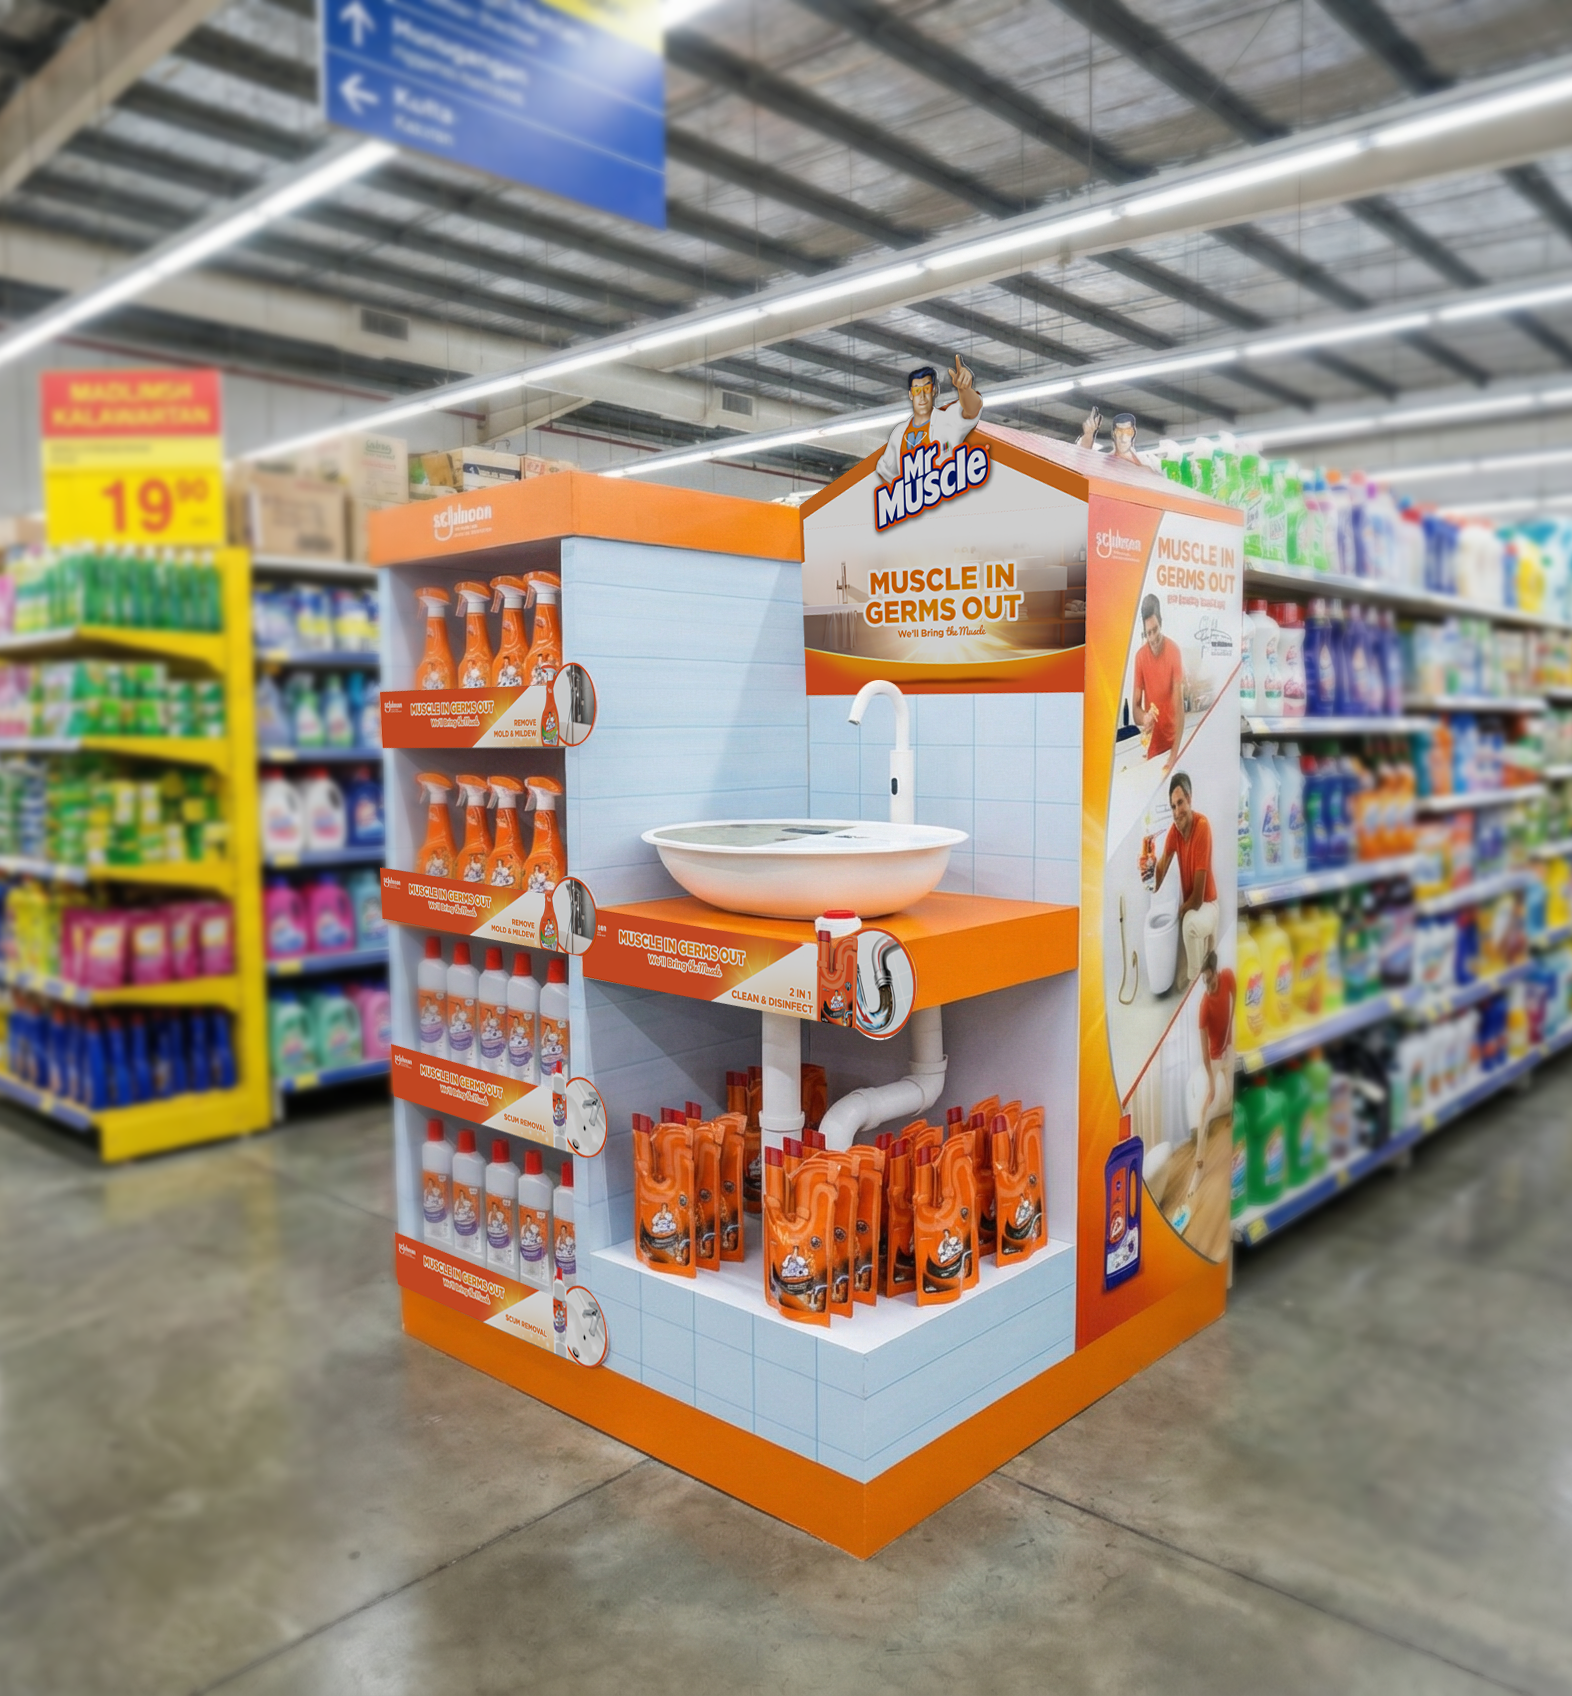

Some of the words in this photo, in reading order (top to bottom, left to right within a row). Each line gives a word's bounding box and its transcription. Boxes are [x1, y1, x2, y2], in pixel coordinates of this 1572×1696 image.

[903, 443, 938, 483] Mr
[101, 478, 174, 534] 19
[1158, 537, 1217, 566] MUSCLE
[1221, 547, 1235, 569] IN
[869, 565, 978, 595] MUSCLE
[986, 563, 1015, 588] IN
[1156, 564, 1205, 591] GERMS
[1208, 572, 1235, 594] OUT
[865, 598, 956, 624] GERMS
[961, 594, 1022, 620] OUT
[921, 627, 944, 638] Bring
[946, 626, 958, 637] the
[959, 625, 986, 637] Muscle
[410, 703, 439, 716] MUSCLE
[441, 702, 450, 715] IN
[451, 701, 477, 715] GERMS
[477, 701, 494, 714] OUT
[494, 730, 509, 738] MOLD
[510, 730, 514, 738] &
[515, 729, 537, 738] MILDEW
[514, 719, 536, 727] REMOVE
[409, 883, 438, 898] MUSCLE
[438, 889, 448, 900] IN
[448, 891, 474, 904] GERMS
[474, 896, 491, 908] OUT
[491, 925, 507, 934] MOLD
[512, 929, 535, 939] MILDEW
[512, 919, 535, 929] REMOVE
[618, 929, 664, 951] MUSCLE
[664, 939, 677, 954] IN
[678, 941, 719, 962] GERMS
[719, 950, 746, 967] OUT
[648, 953, 666, 967] We'll
[666, 957, 688, 973] Bring
[688, 958, 698, 972] the
[697, 961, 723, 978] Muscle
[731, 989, 759, 1004] CLEAN
[761, 994, 767, 1004] &
[768, 996, 814, 1014] DISINFECT
[789, 987, 795, 996] 2
[797, 989, 806, 999] IN
[807, 990, 812, 1000] 1
[420, 1063, 449, 1083] MUSCLE
[450, 1073, 459, 1086] IN
[459, 1076, 486, 1094] GERMS
[486, 1083, 503, 1099] OUT
[504, 1113, 519, 1126] SCUM
[520, 1118, 546, 1133] REMOVAL
[423, 1255, 452, 1275] MUSCLE
[453, 1268, 461, 1281] IN
[461, 1271, 487, 1292] GERMS
[488, 1283, 505, 1299] OUT
[505, 1314, 521, 1326] SCUM
[521, 1319, 547, 1338] REMOVAL
